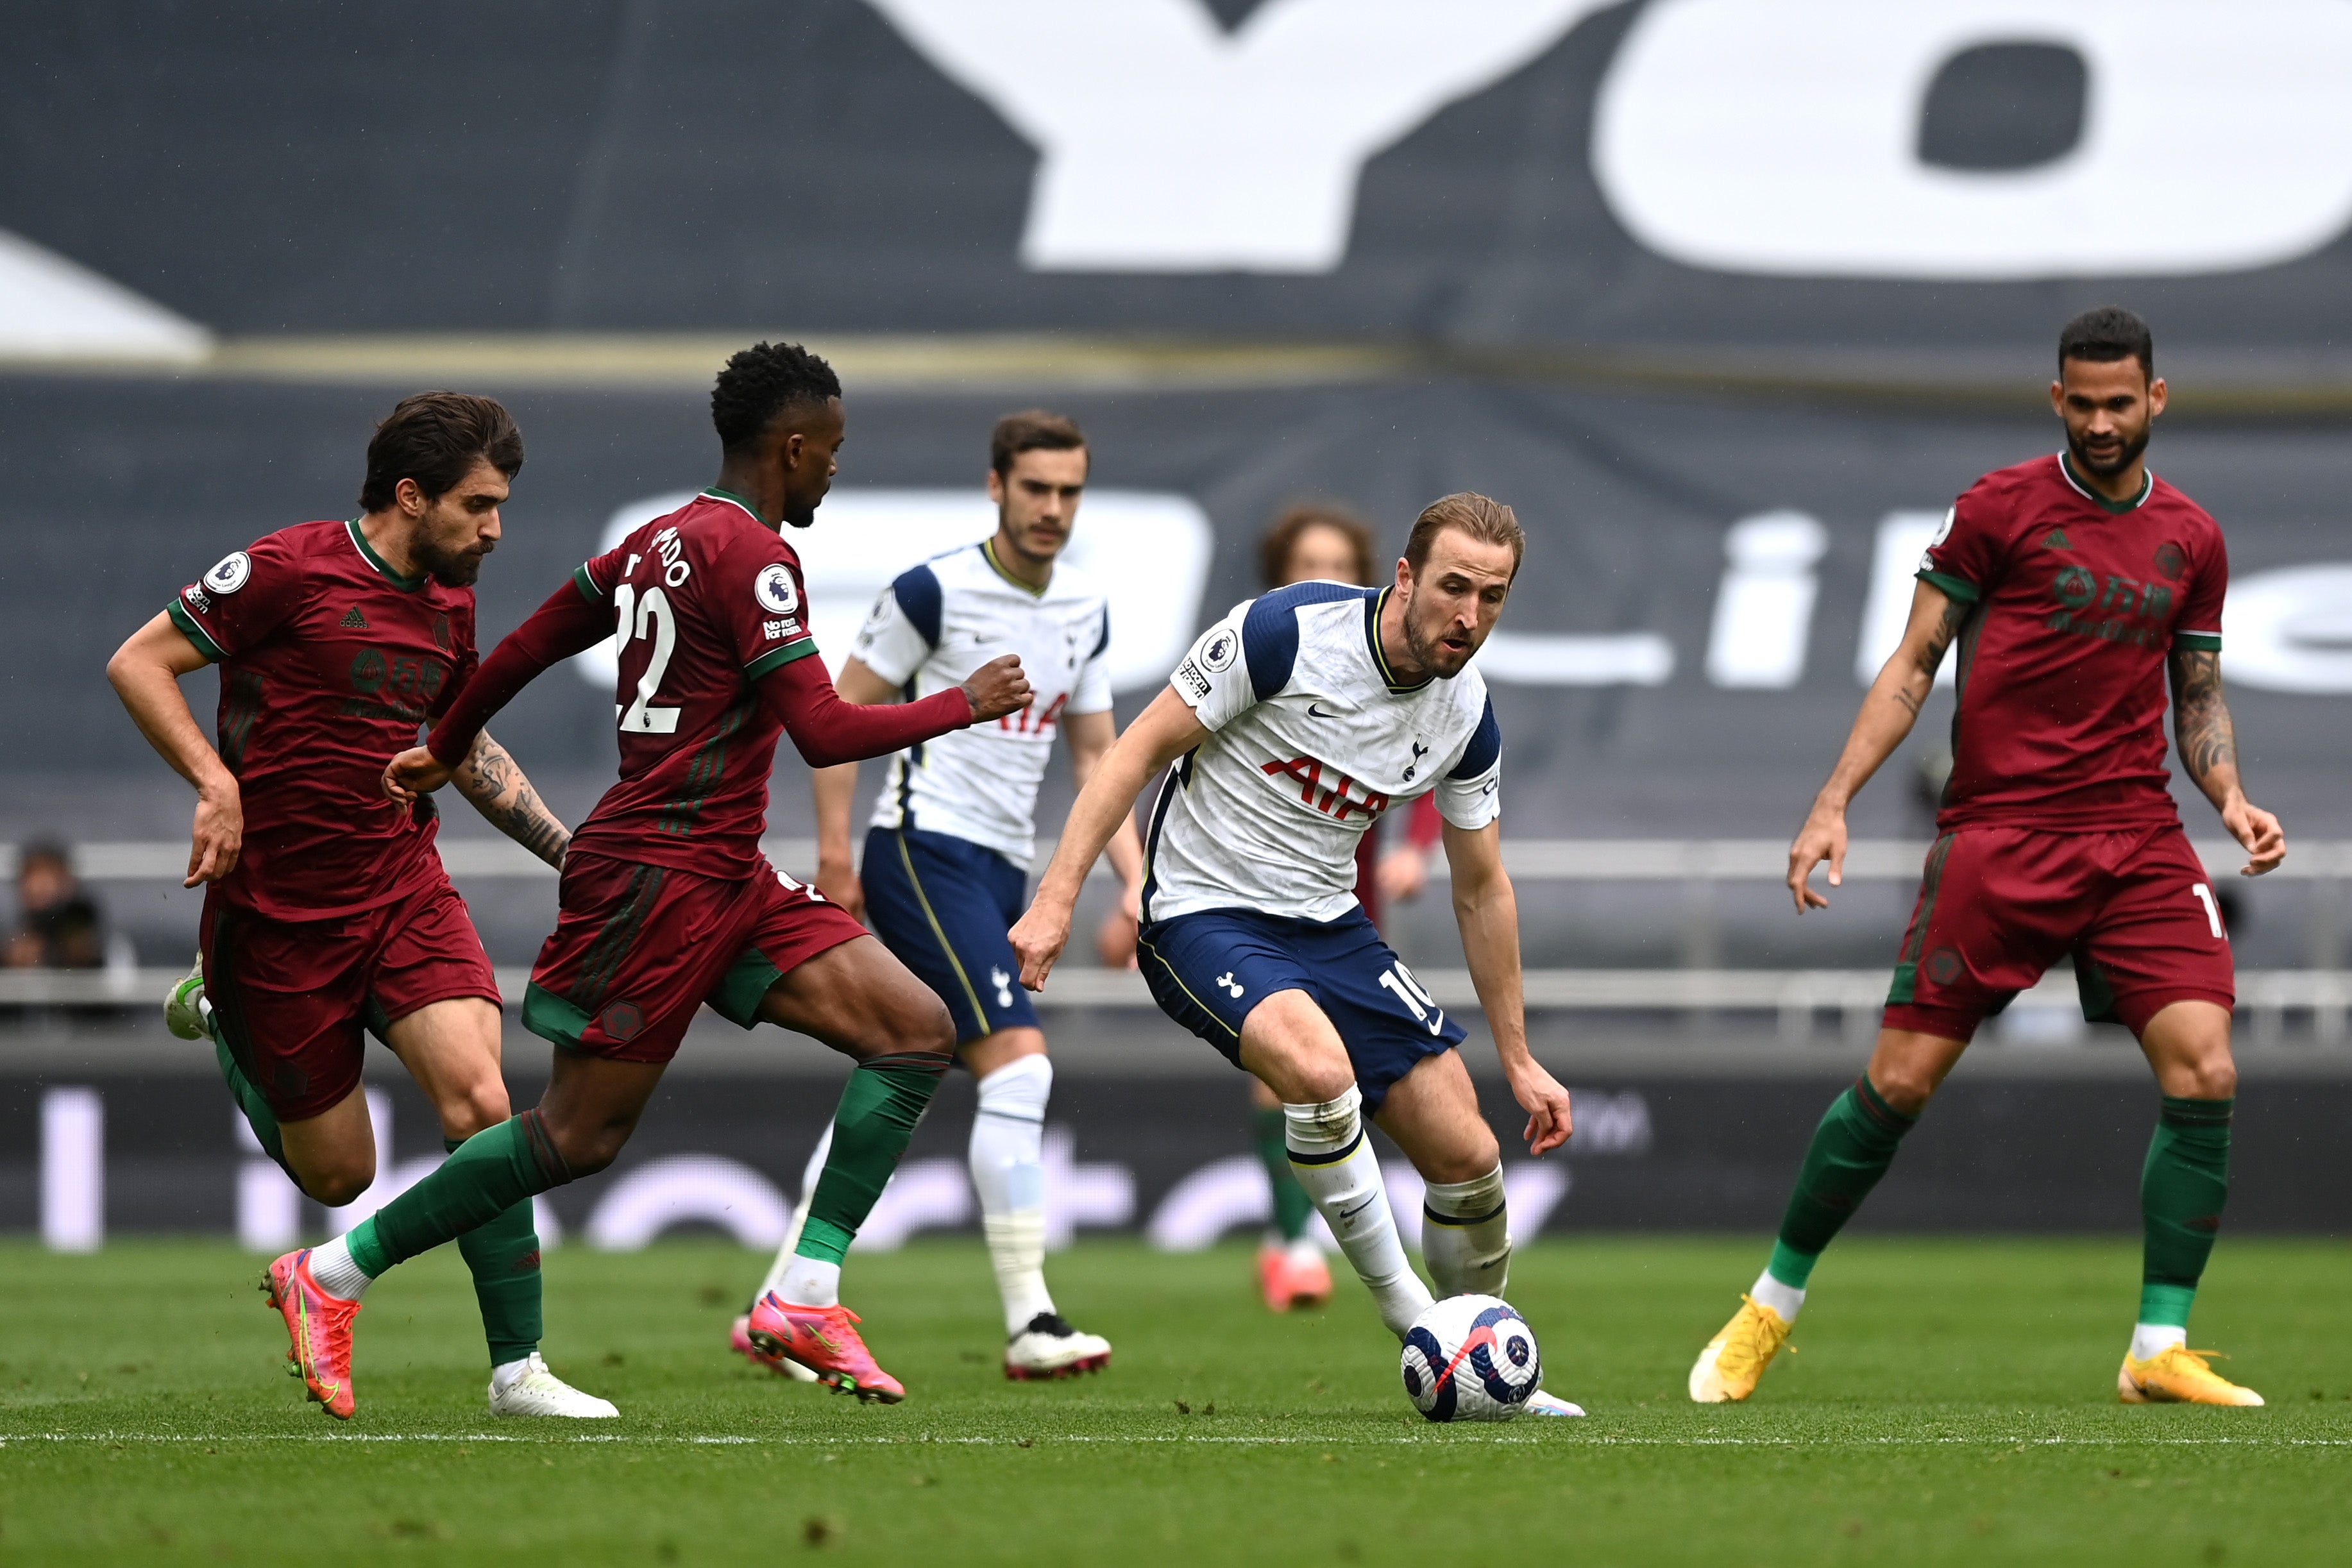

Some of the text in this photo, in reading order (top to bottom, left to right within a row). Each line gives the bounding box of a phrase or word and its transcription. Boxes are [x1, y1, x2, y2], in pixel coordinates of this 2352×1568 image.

[339, 620, 369, 629] adidas
[762, 620, 781, 630] No
[1188, 667, 1208, 691] room
[1260, 755, 1389, 821] AIA
[2191, 882, 2225, 940] 1
[1378, 959, 1436, 1022] 10
